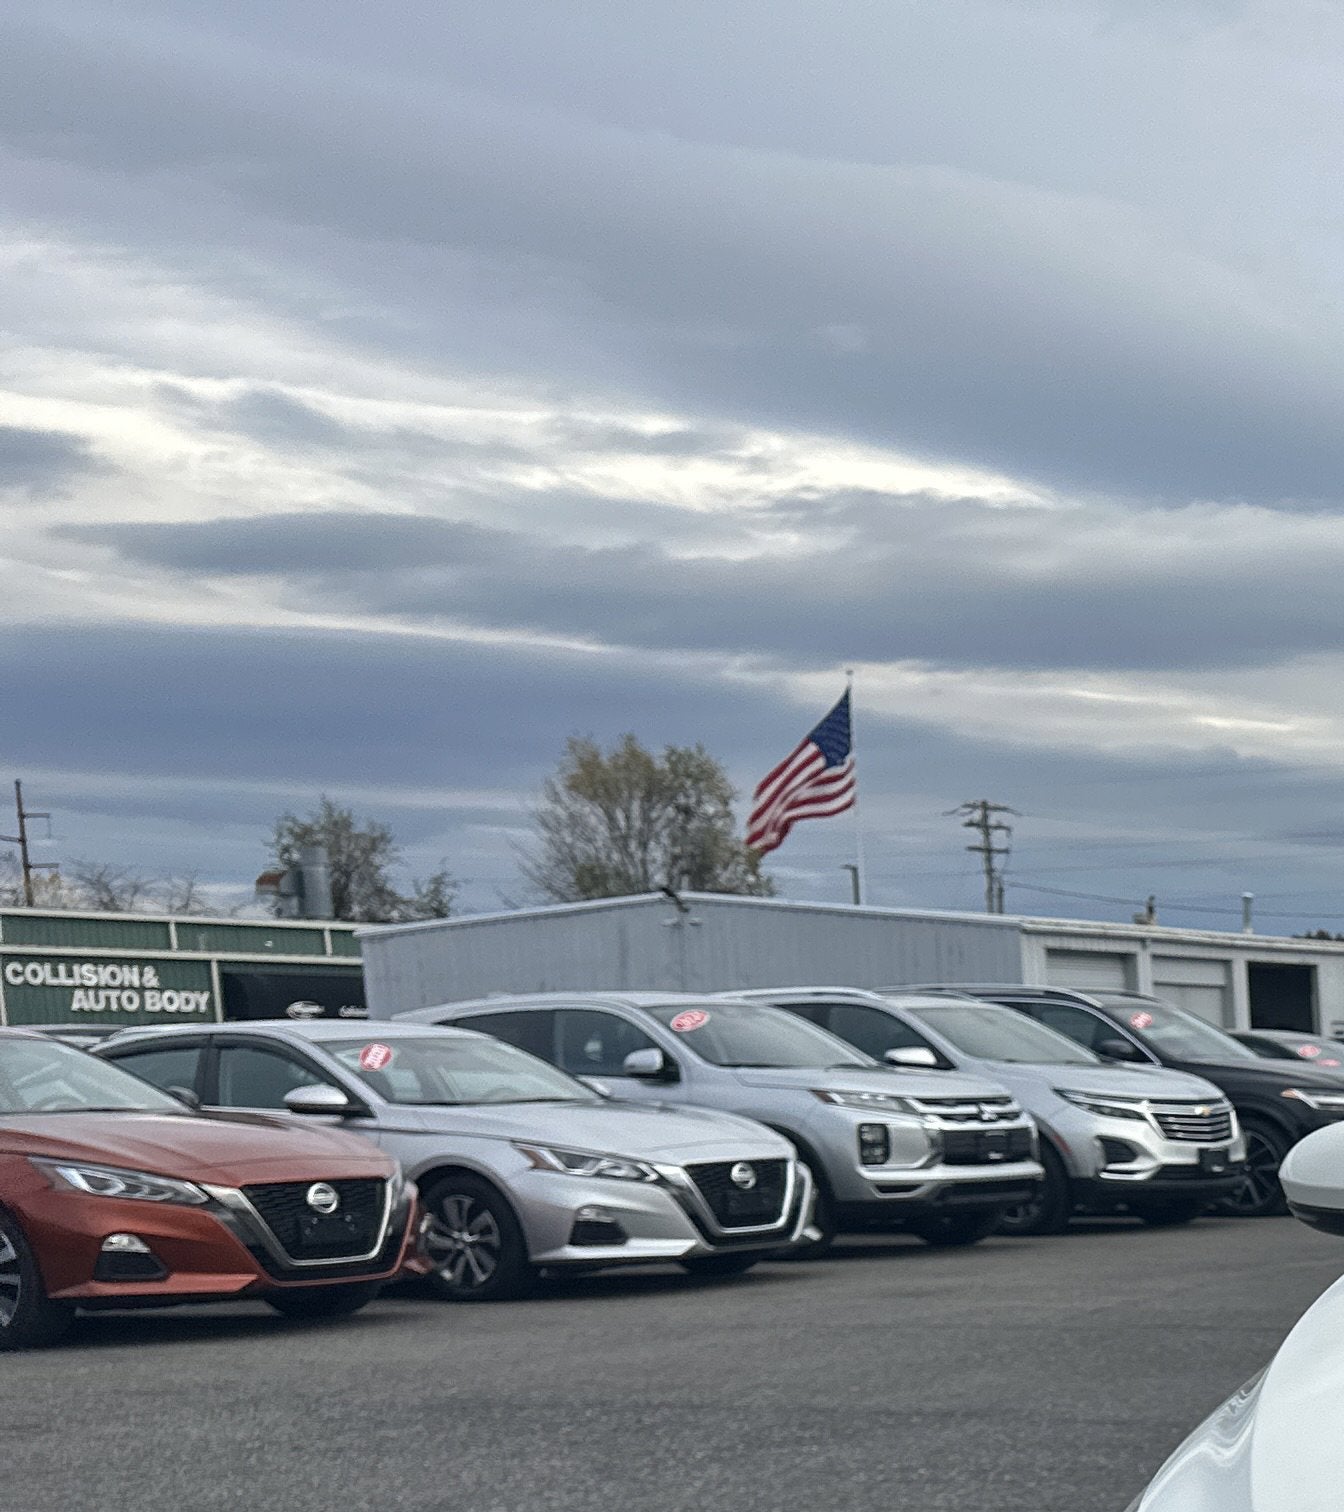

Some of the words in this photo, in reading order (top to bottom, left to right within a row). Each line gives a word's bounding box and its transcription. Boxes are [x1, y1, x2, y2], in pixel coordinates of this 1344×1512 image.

[5, 961, 140, 988] COLLISION
[71, 989, 140, 1013] AUTO
[144, 989, 210, 1013] BODY
